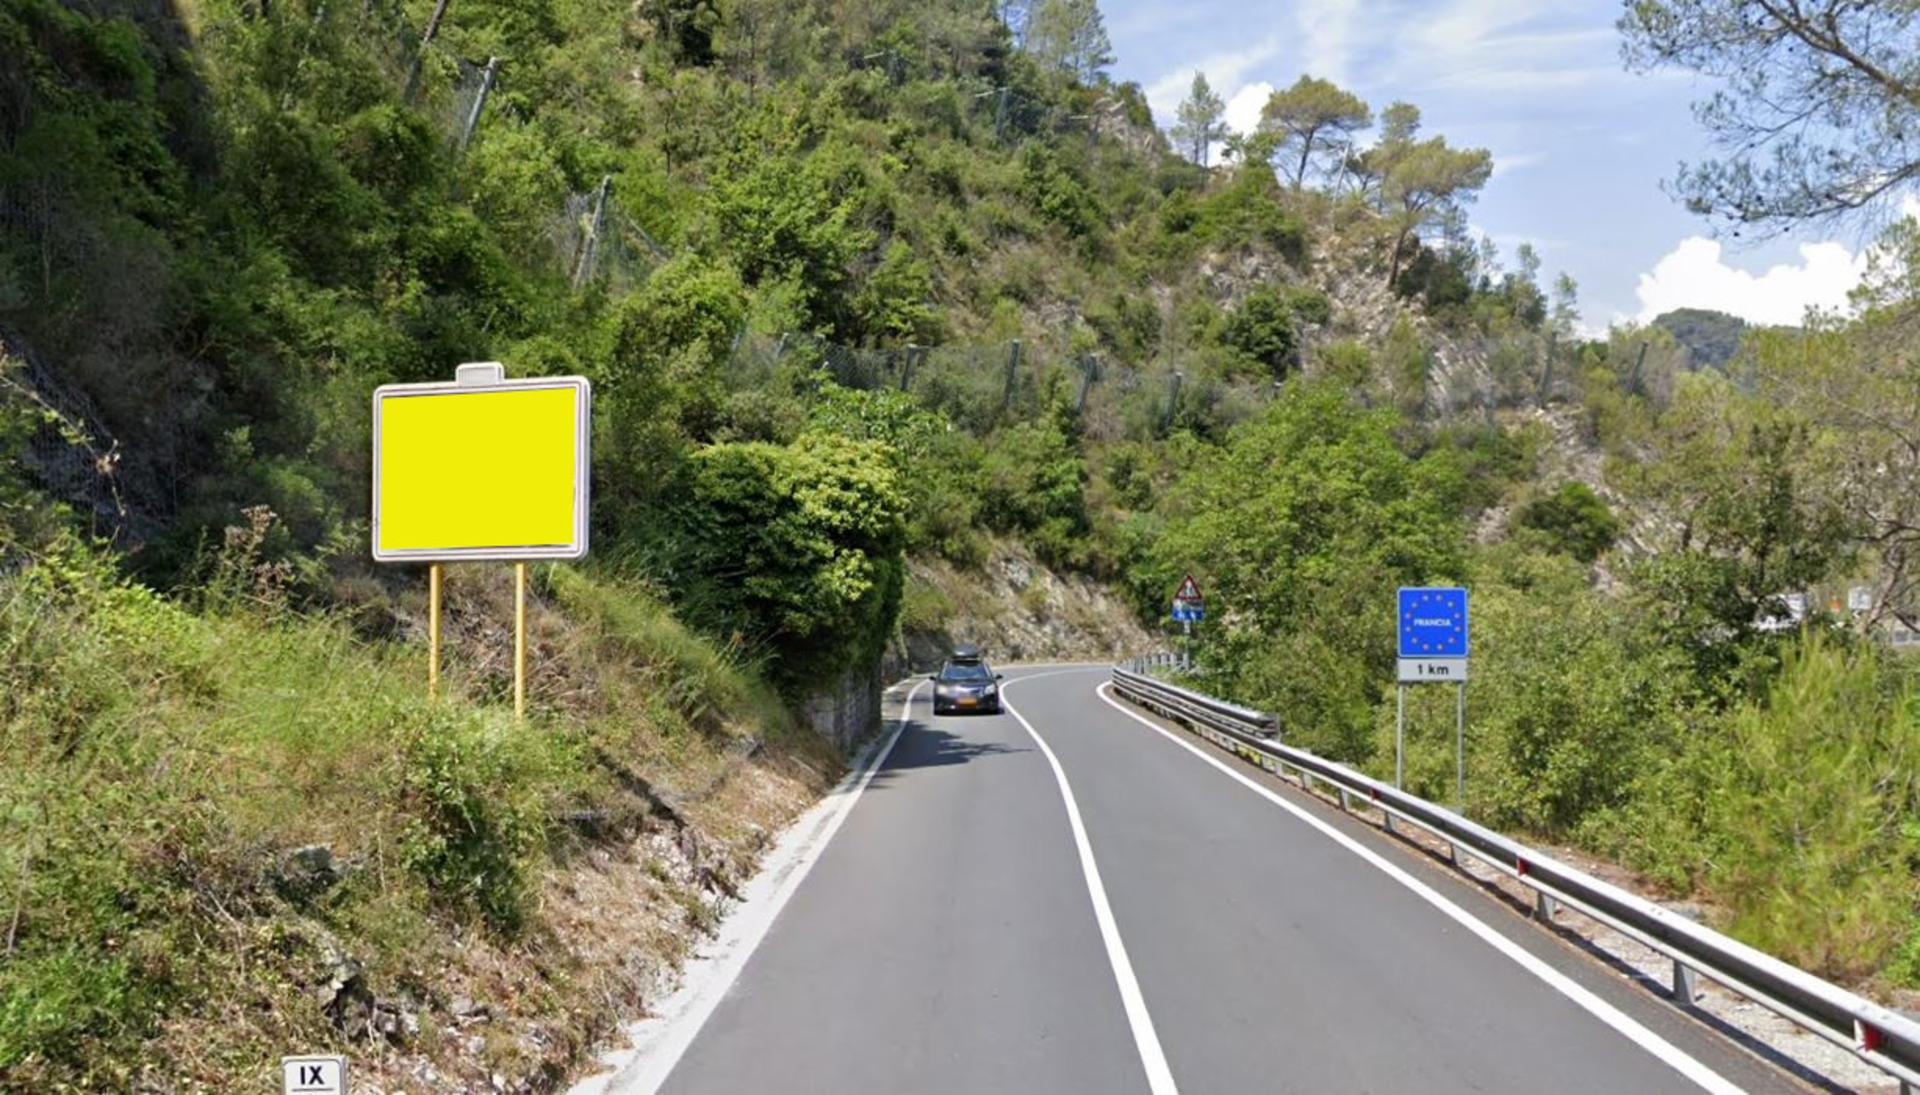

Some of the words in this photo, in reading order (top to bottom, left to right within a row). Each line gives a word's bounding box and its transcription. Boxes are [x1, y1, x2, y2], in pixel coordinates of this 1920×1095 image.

[1414, 618, 1452, 626] FRANCIA
[1418, 664, 1422, 674] 1
[1428, 664, 1448, 674] km
[300, 1066, 324, 1084] IX
